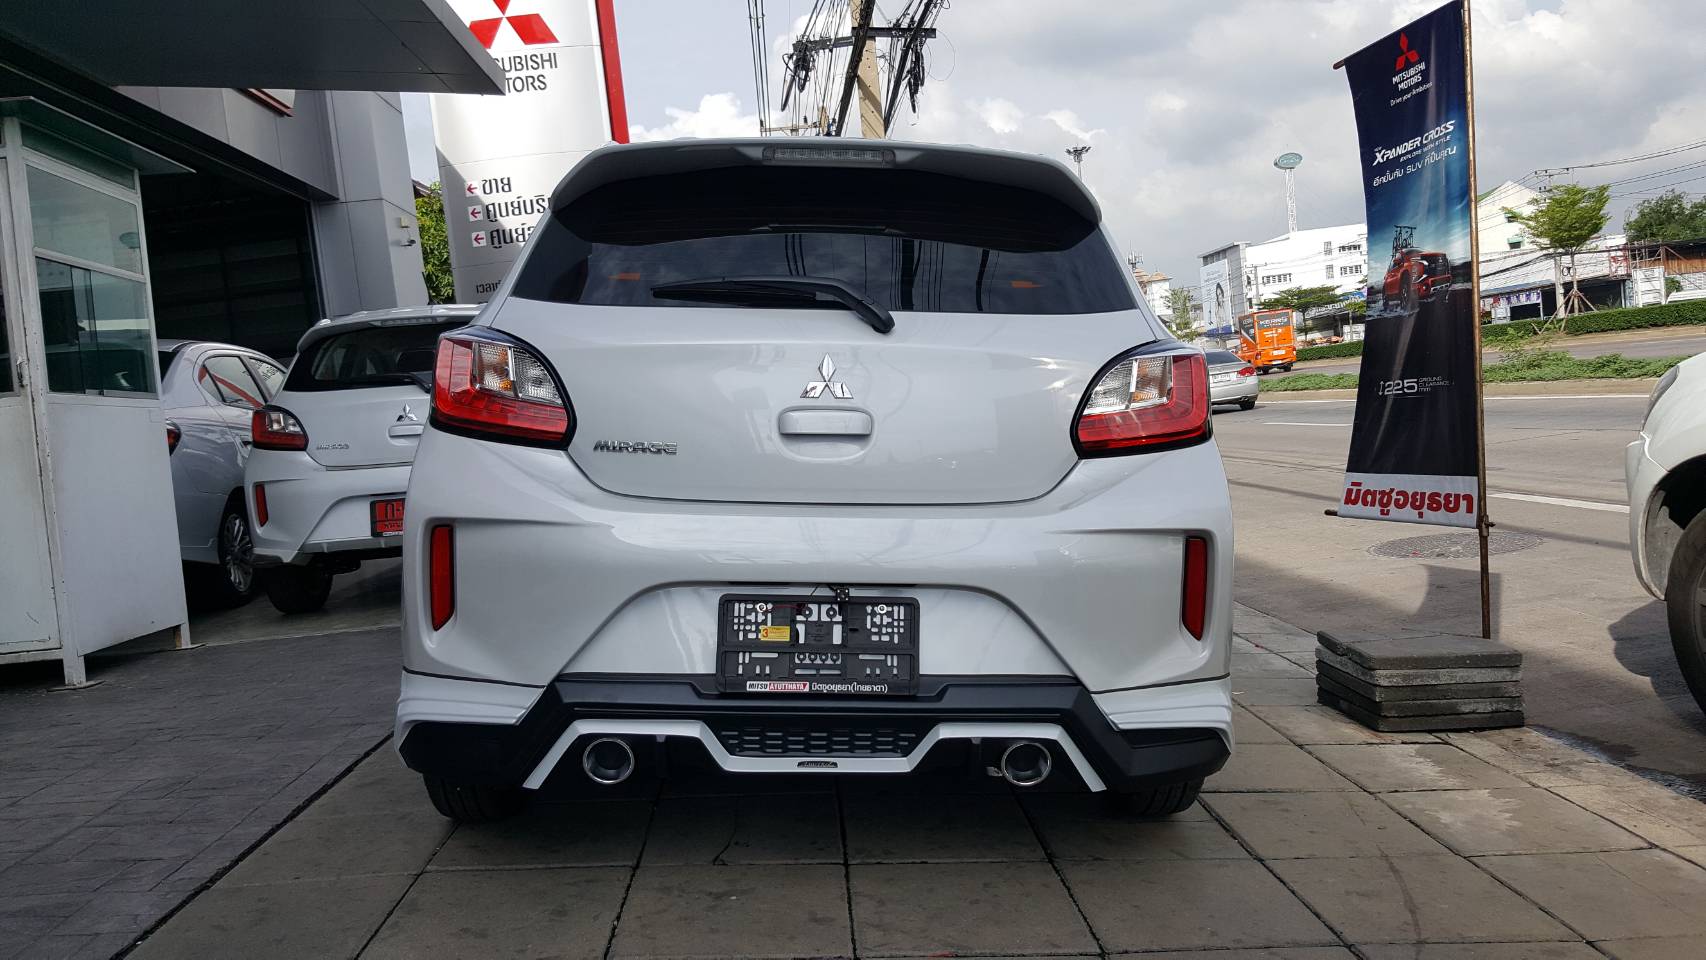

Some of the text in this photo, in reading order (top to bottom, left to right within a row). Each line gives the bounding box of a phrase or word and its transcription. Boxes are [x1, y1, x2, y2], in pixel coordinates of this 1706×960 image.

[494, 52, 558, 73] UBISHI
[1392, 61, 1425, 85] MITSUBISHI
[1398, 73, 1422, 91] MOTORS
[505, 74, 548, 94] TORS
[1372, 120, 1456, 167] XPANDER CROSS
[1406, 160, 1424, 174] SUV
[481, 176, 512, 195] ขาย
[485, 194, 551, 223] ศูนย์บริ
[1384, 378, 1418, 395] 225
[593, 440, 678, 456] MIRAGE
[1343, 481, 1474, 519] มิตซูอยุธยา
[748, 682, 768, 691] MITSU
[768, 682, 804, 691] AYUTTHAYA
